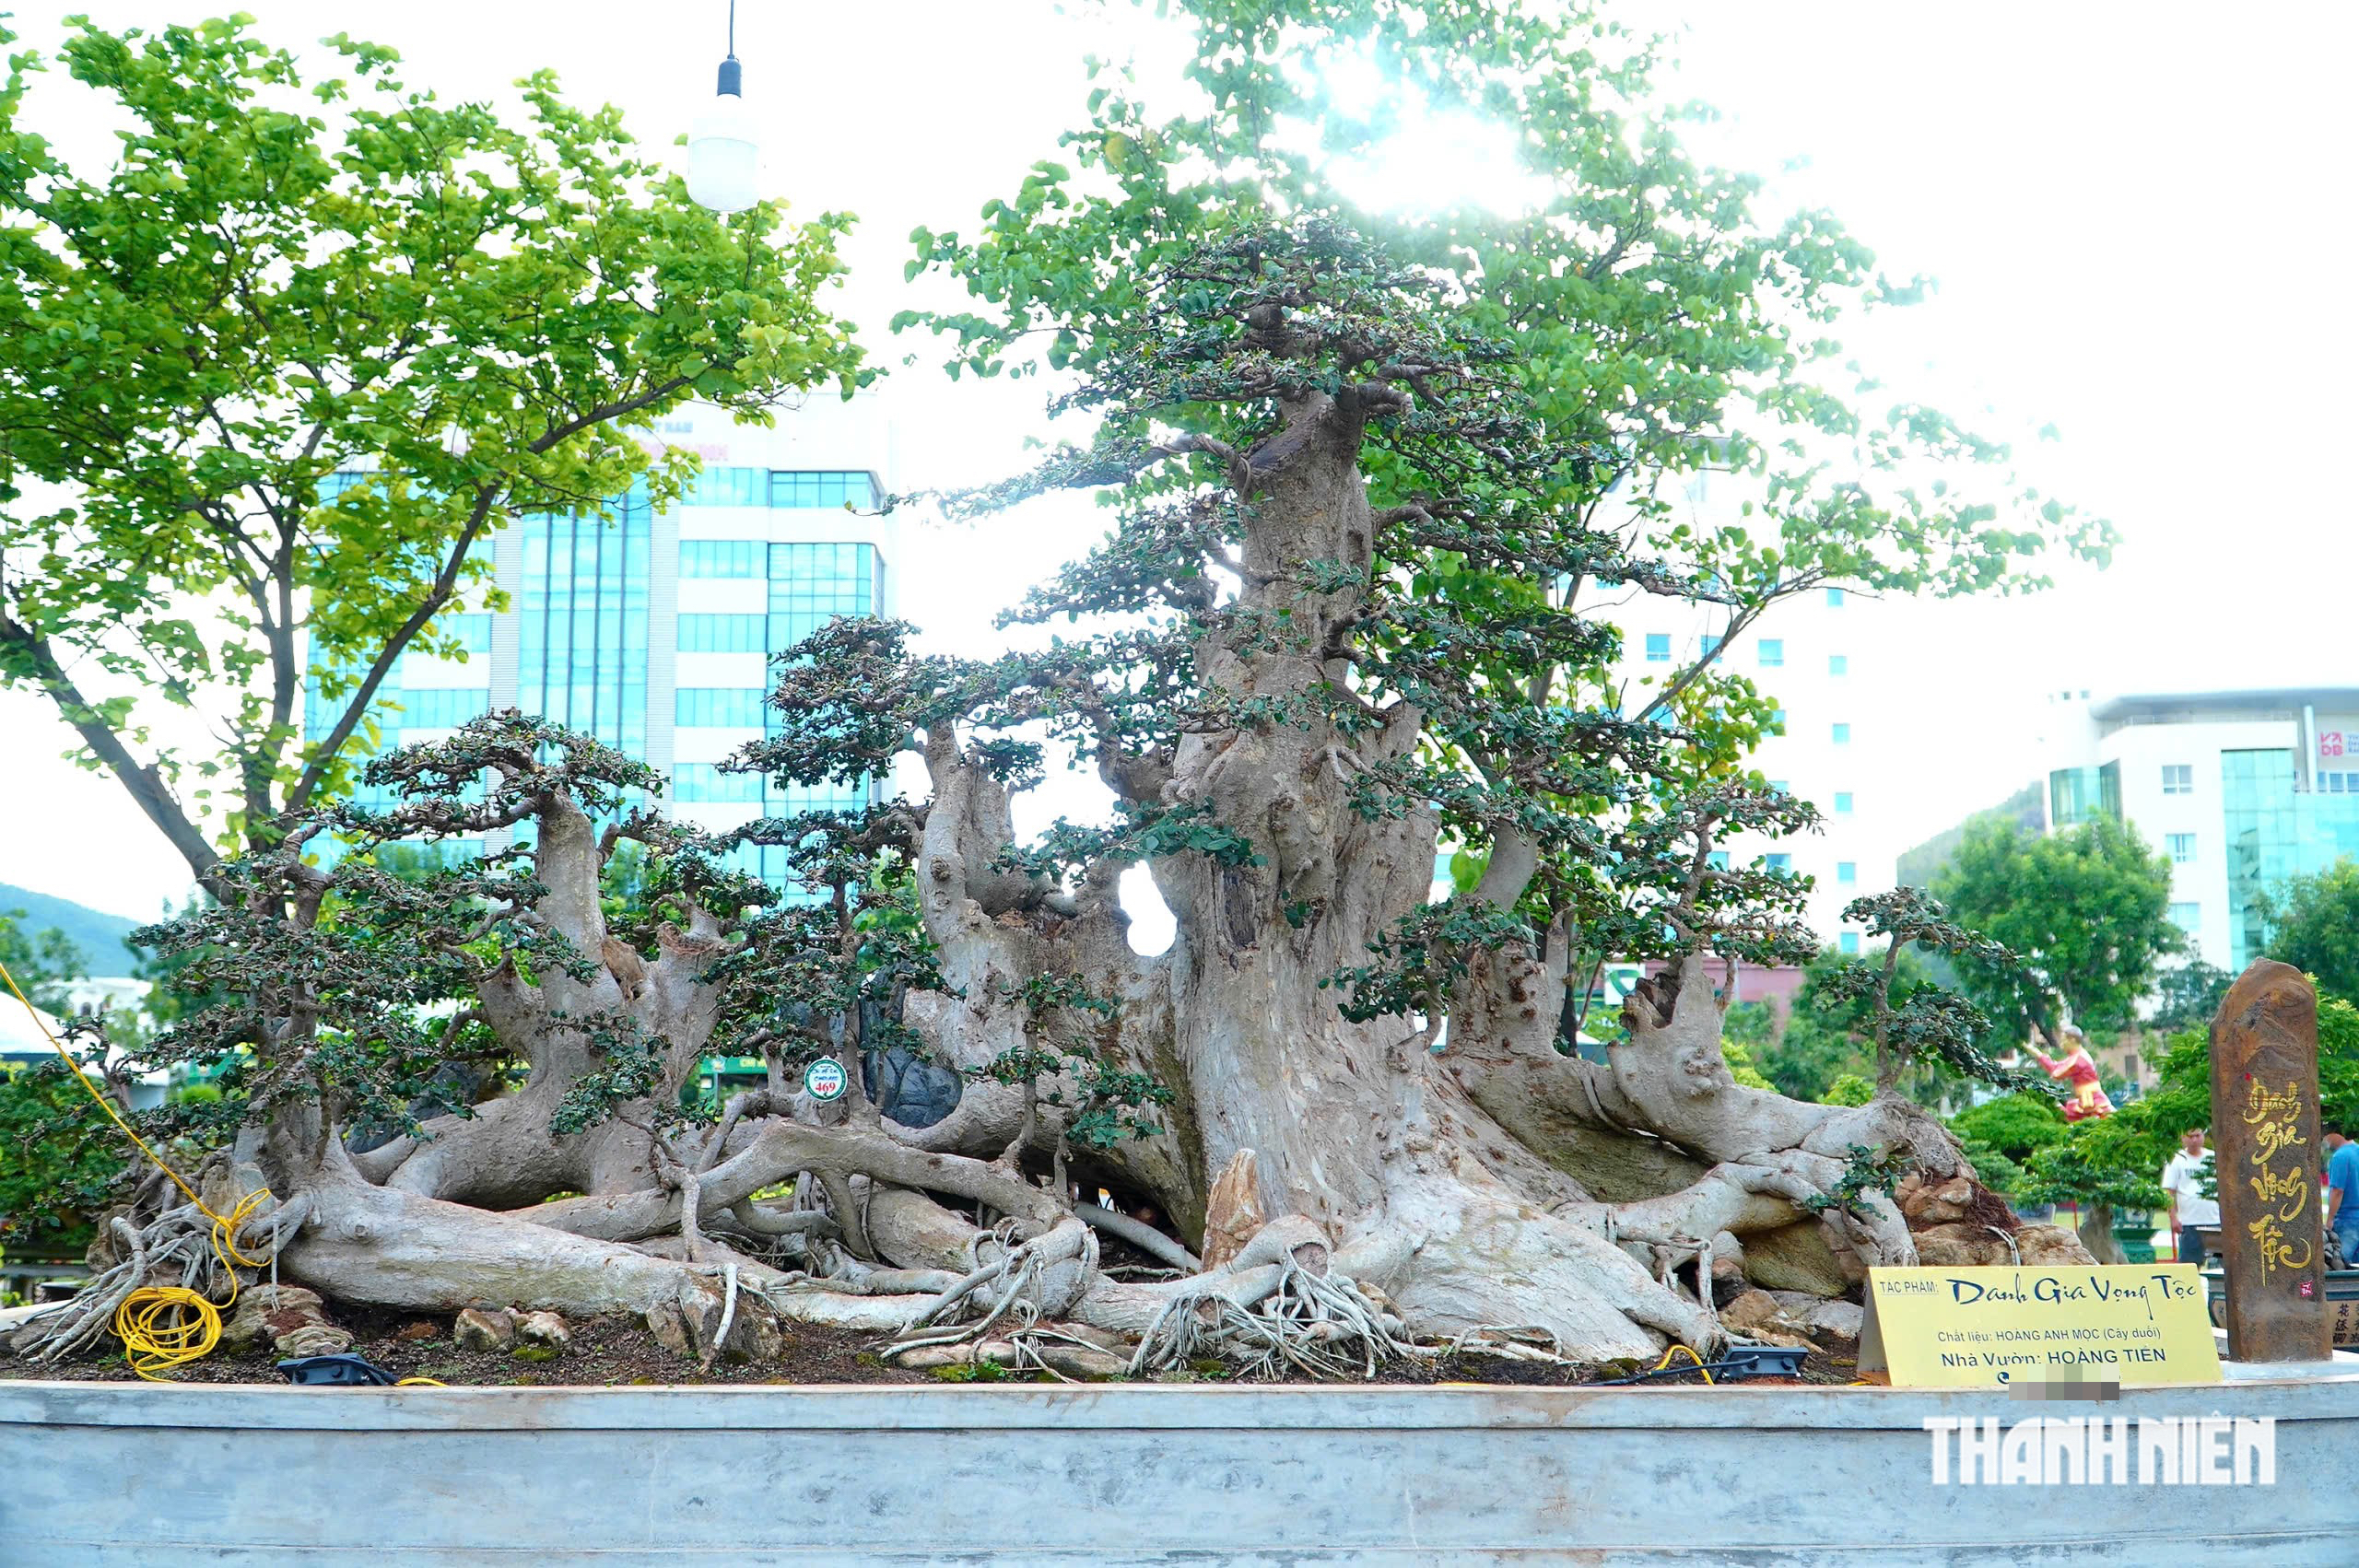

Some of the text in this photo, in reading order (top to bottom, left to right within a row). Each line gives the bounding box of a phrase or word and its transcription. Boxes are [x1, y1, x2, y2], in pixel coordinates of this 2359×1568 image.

[816, 1082, 836, 1093] 469
[1946, 1272, 2197, 1321] Danh Gia Vọng Tộc
[2045, 1329, 2069, 1340] ANH
[1941, 1352, 1978, 1367] Nhà
[1982, 1352, 2042, 1366] Vườn:
[2048, 1346, 2118, 1364] HOÀNG
